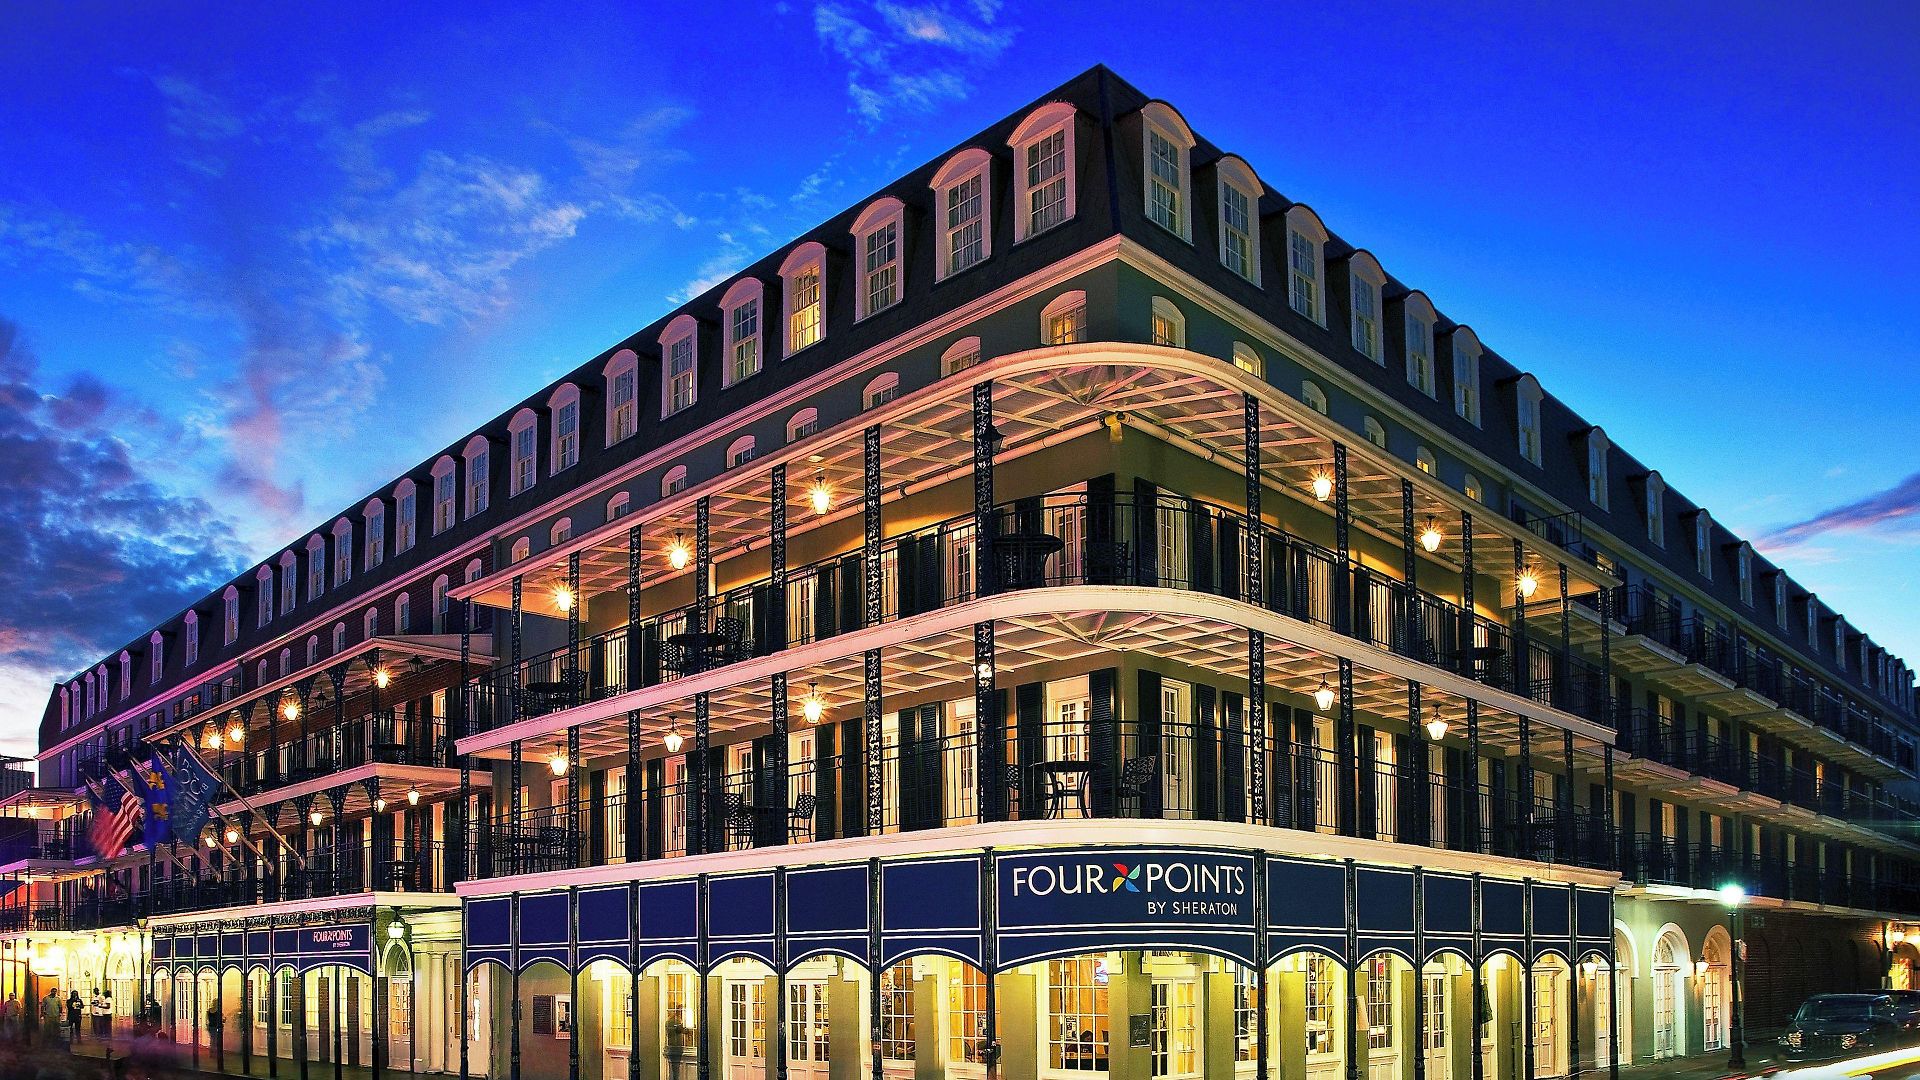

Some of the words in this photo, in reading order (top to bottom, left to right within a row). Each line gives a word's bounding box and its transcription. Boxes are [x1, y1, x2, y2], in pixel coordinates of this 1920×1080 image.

[1013, 864, 1108, 896] FOUR
[1146, 863, 1245, 895] POINTS
[1147, 902, 1167, 915] BY
[1172, 902, 1238, 916] SHERATON
[313, 931, 327, 942] FOUR
